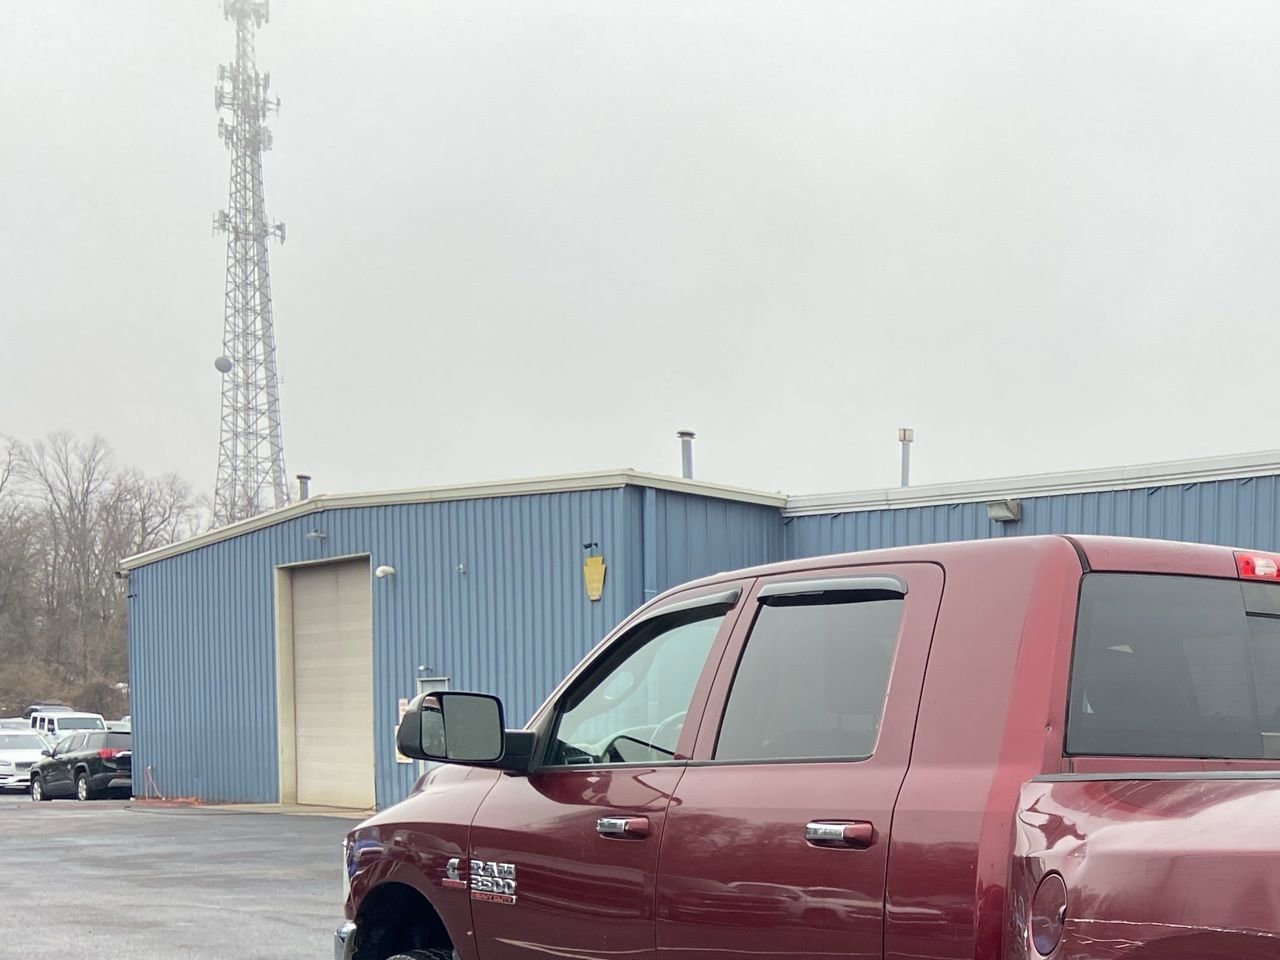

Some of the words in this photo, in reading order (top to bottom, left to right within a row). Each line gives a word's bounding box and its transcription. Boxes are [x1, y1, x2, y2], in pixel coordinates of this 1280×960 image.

[470, 860, 515, 879] RAM
[470, 875, 517, 894] 3500
[472, 892, 492, 900] HEAVY
[493, 894, 512, 903] DUTY
